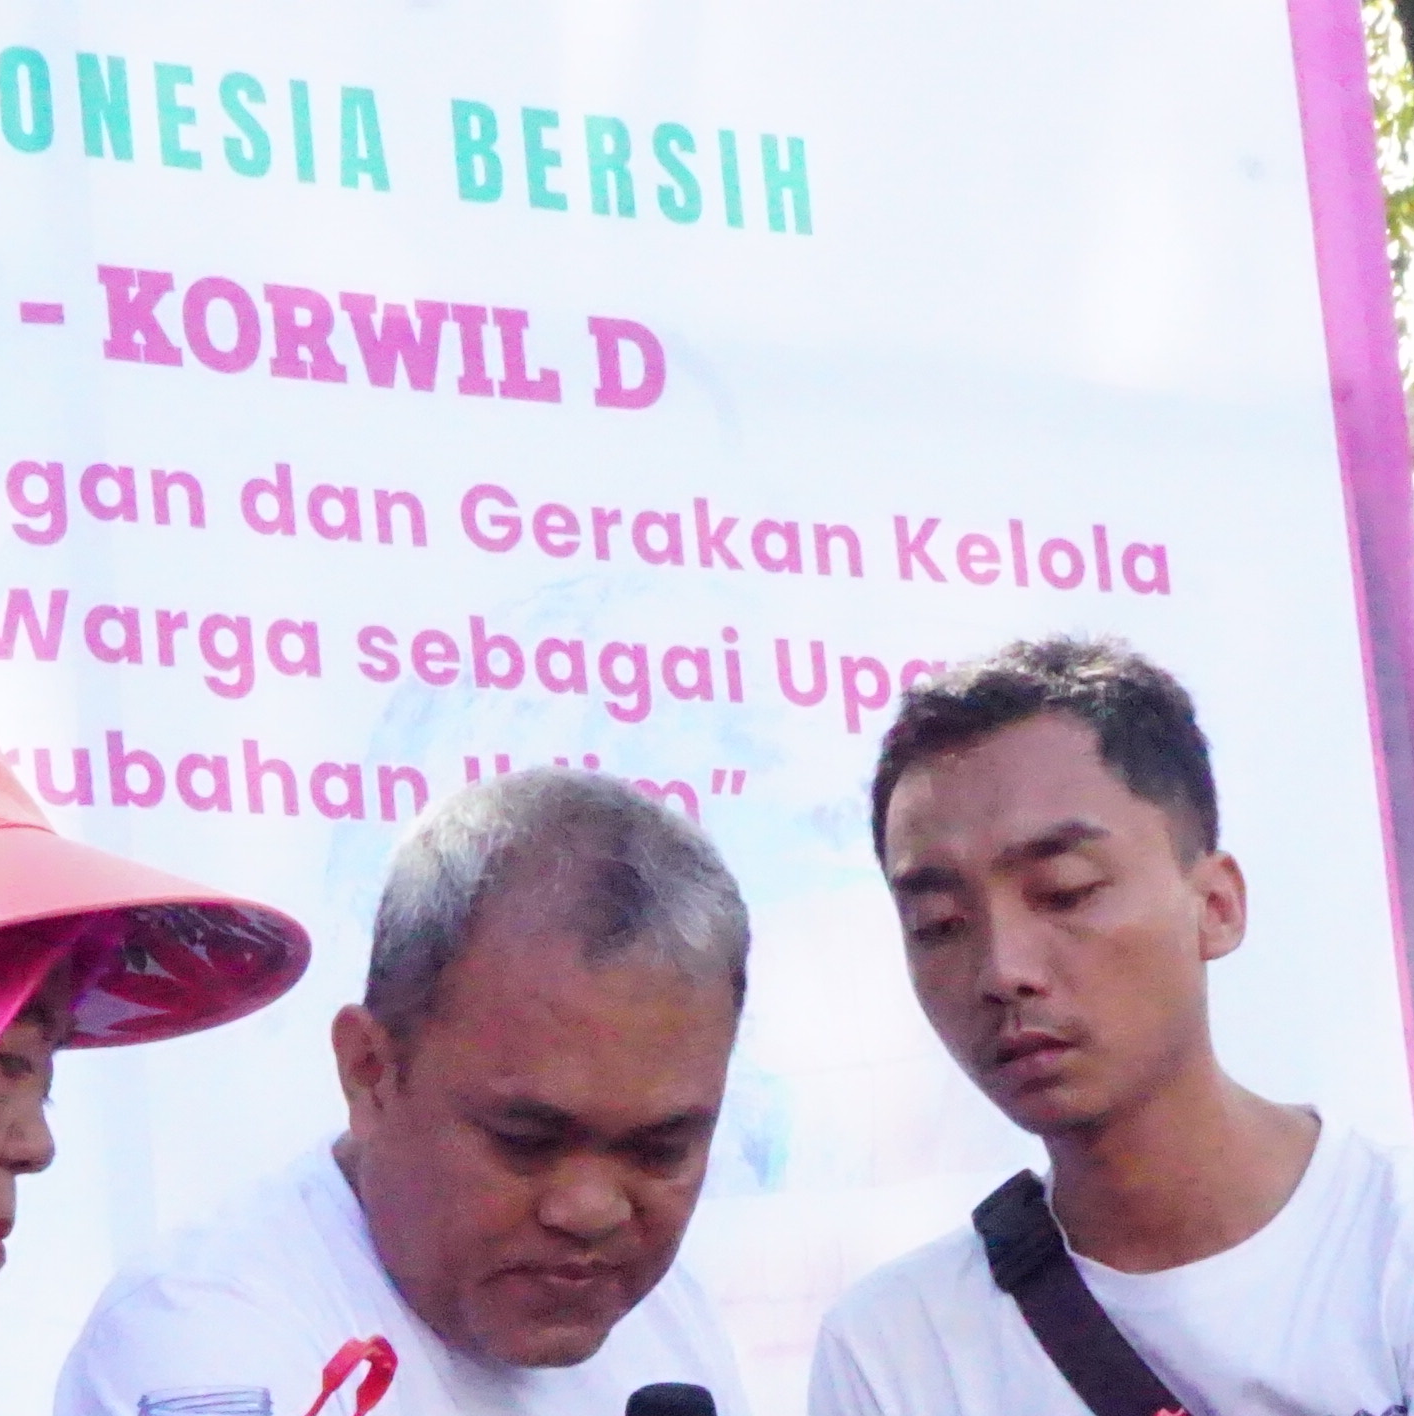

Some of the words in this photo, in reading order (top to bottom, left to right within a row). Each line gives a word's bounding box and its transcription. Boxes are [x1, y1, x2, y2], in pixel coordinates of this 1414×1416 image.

[451, 98, 812, 236] BERSIH
[96, 264, 563, 404] KORWIL
[587, 315, 668, 412] D
[240, 462, 429, 549] dan
[459, 481, 864, 580] Gerakan
[893, 514, 1172, 596] Kelola
[356, 613, 745, 725] sebagai
[774, 637, 951, 735] Upa
[7, 729, 430, 823] ubahan
